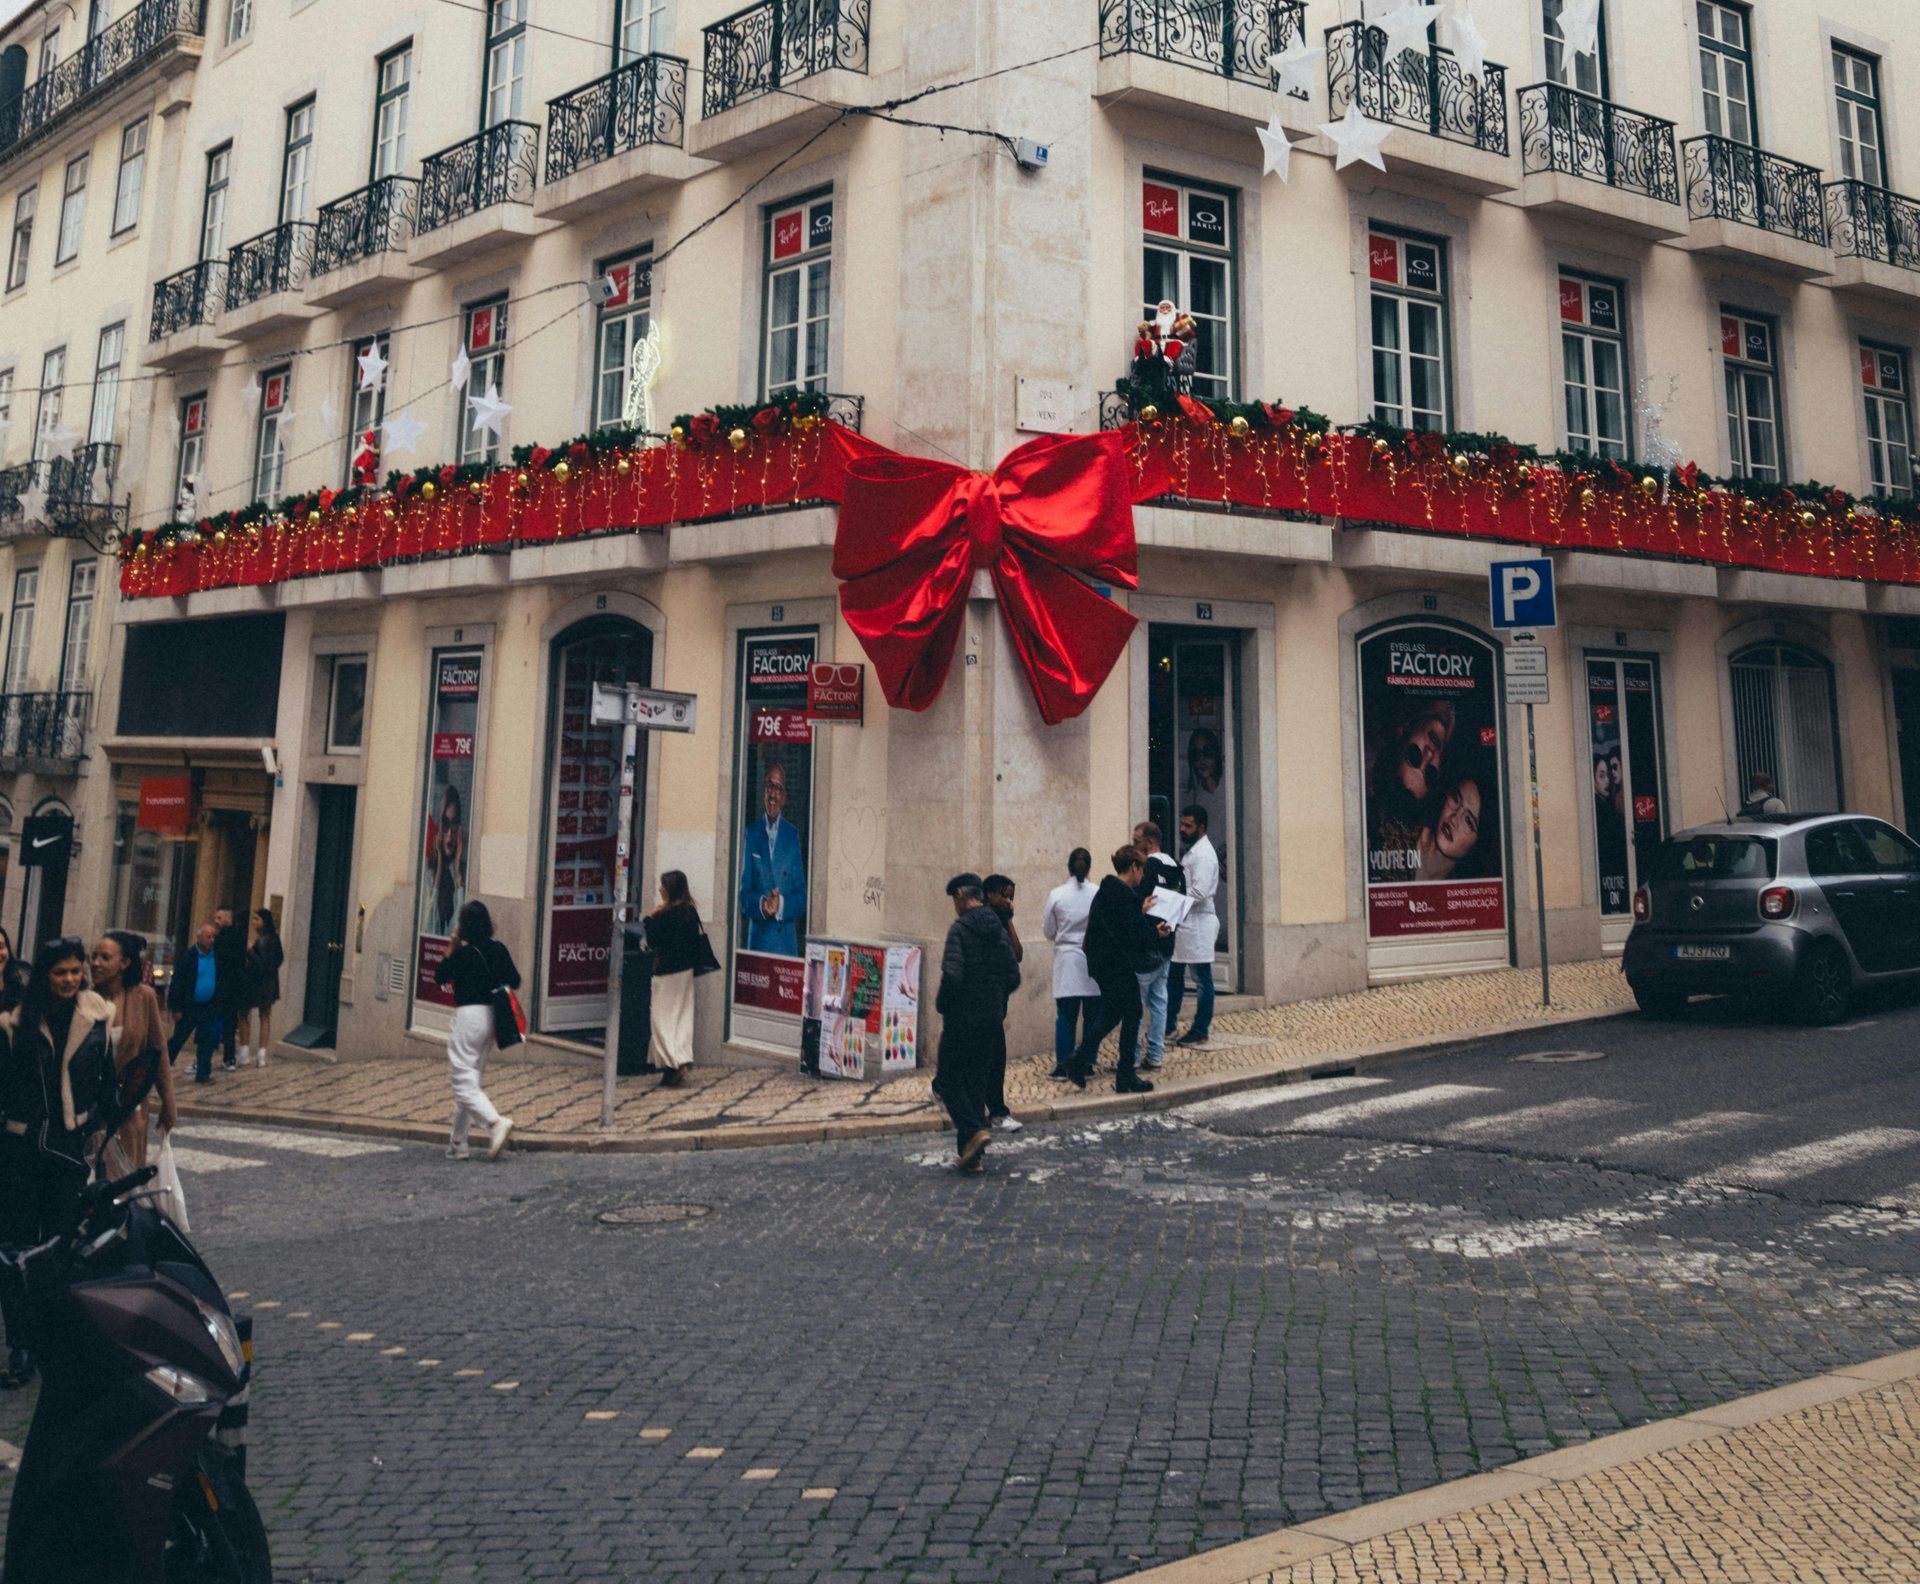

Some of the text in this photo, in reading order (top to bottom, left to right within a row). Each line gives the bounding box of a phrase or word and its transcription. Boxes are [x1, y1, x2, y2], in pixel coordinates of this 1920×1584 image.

[811, 225, 831, 236] OAKLE
[1191, 220, 1222, 231] OAKLEY
[1408, 267, 1434, 277] OAKLEY
[1502, 567, 1540, 621] P
[1390, 642, 1426, 653] EYEGLASS
[753, 653, 811, 674] FACTORY
[1390, 652, 1474, 676] FACTORY
[442, 670, 479, 684] FACTORY
[814, 690, 858, 702] FACTORY
[757, 716, 782, 736] 79€
[455, 738, 472, 754] 79€
[1370, 849, 1422, 870] YOU'RE ON
[1602, 876, 1625, 890] YOU'RE
[1609, 891, 1620, 905] ON
[558, 947, 611, 962] FACTO
